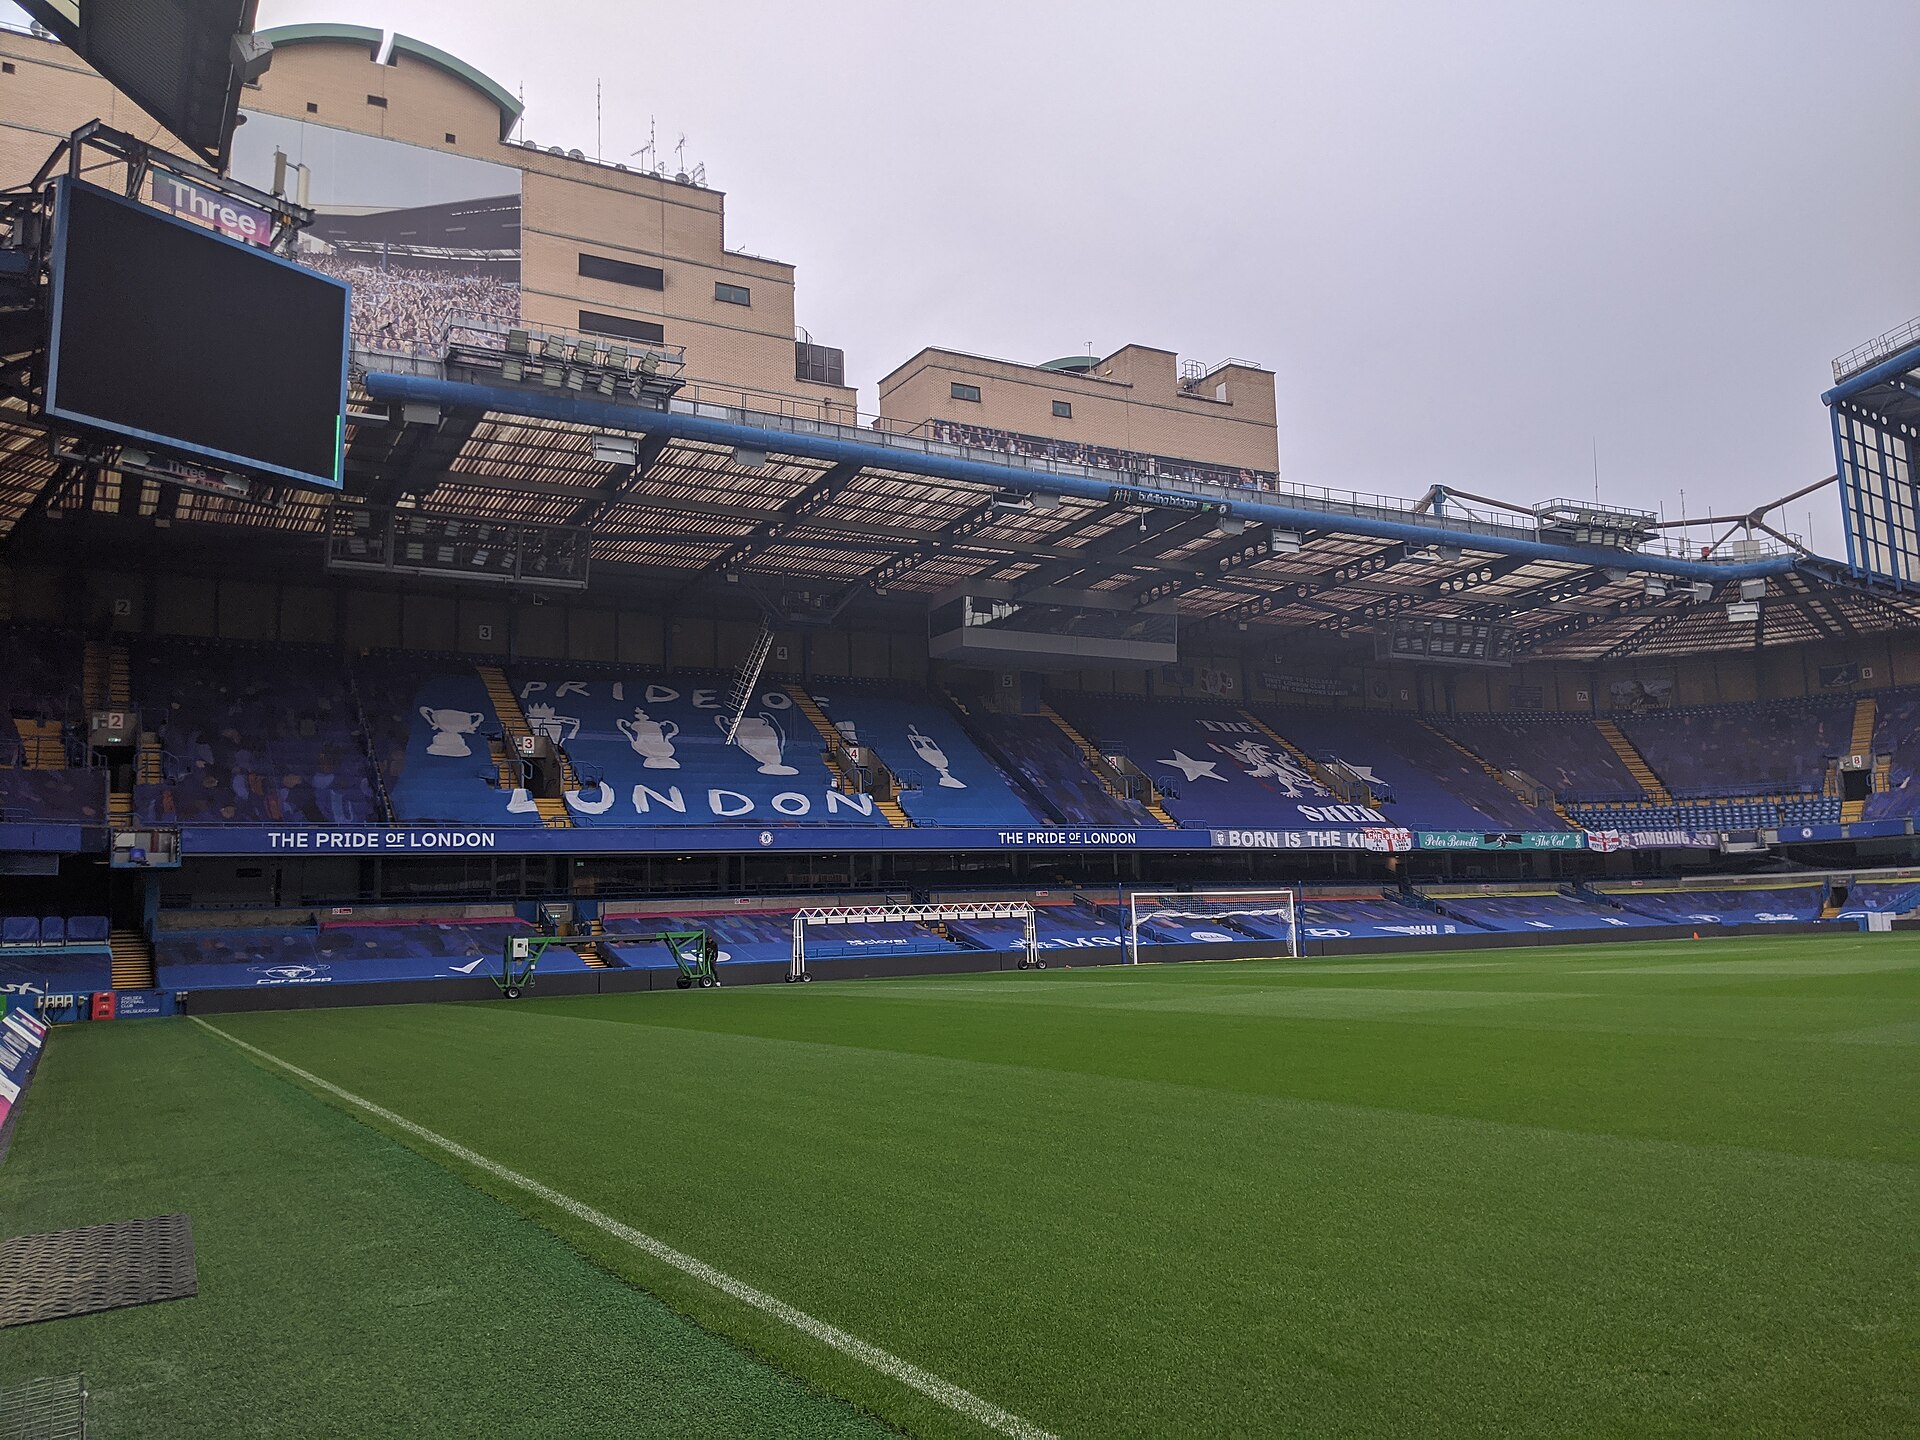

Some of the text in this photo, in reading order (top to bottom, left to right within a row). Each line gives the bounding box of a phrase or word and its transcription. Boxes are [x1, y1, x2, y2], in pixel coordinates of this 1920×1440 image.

[168, 178, 257, 235] Three
[167, 459, 207, 478] Three
[118, 601, 128, 613] 2
[481, 627, 489, 638] 3
[778, 648, 787, 658] 4
[1004, 675, 1011, 686] 5
[520, 681, 722, 708] PRIDE
[1577, 692, 1587, 700] 7A
[111, 715, 121, 727] 2
[1195, 719, 1260, 733] THE
[524, 738, 533, 749] 3
[850, 749, 858, 759] 4
[1854, 756, 1860, 765] 8
[506, 781, 873, 817] LONDON
[267, 832, 495, 848] THE PRIDE OF LONDON
[998, 832, 1136, 844] THE PRIDE OF LONDON
[1229, 830, 1278, 847] BORN
[1285, 832, 1301, 847] IS
[1308, 831, 1342, 847] THE
[1367, 832, 1409, 840] CHELSEA FC
[1424, 834, 1446, 847] Peter
[1447, 835, 1479, 847] Bonetti
[1632, 831, 1690, 846] TAMBLING
